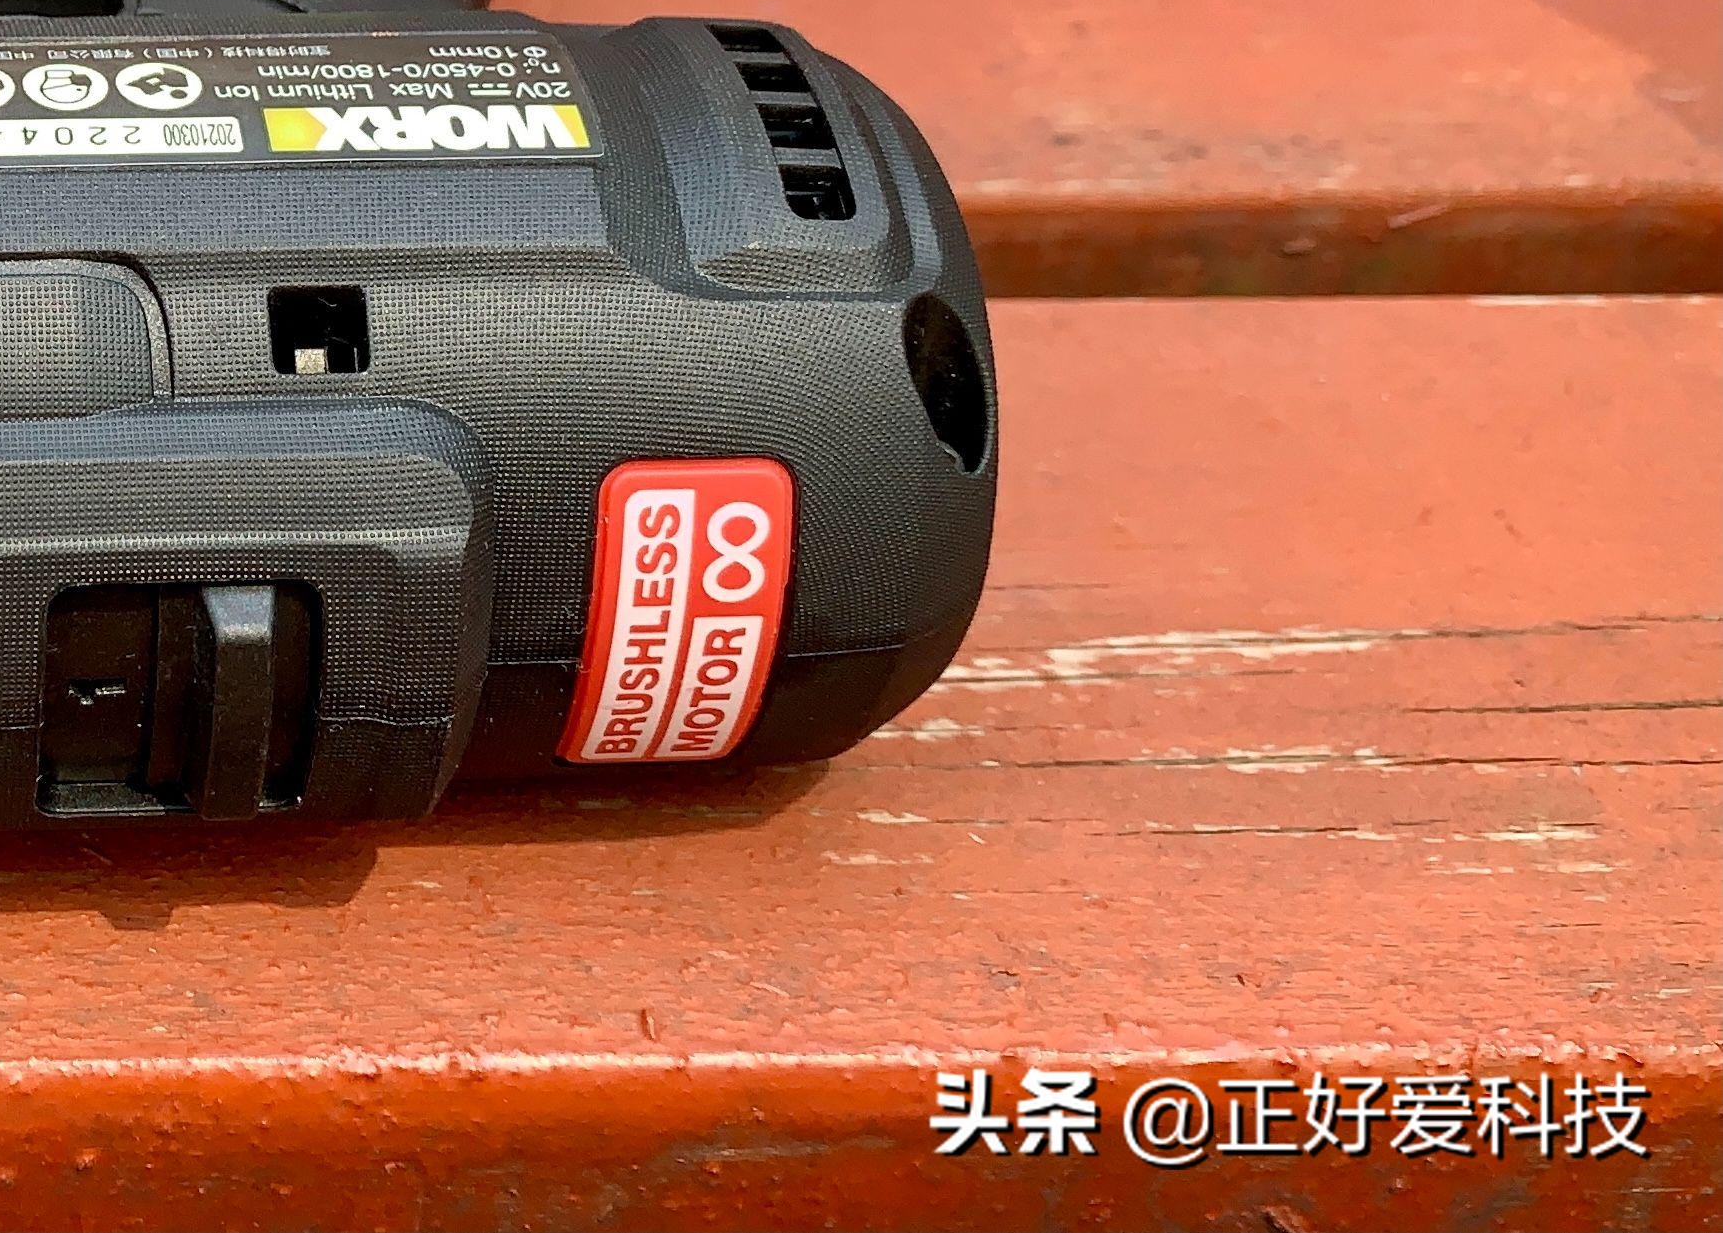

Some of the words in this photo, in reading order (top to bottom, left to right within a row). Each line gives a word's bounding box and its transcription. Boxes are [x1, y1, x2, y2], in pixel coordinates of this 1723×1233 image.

[213, 85, 261, 102] Ion
[266, 82, 375, 102] Lithium
[388, 82, 454, 100] Max
[163, 122, 236, 147] 20210300
[304, 103, 579, 152] WORX
[594, 502, 681, 755] BRUSHLESS
[669, 626, 747, 753] MOTOR
